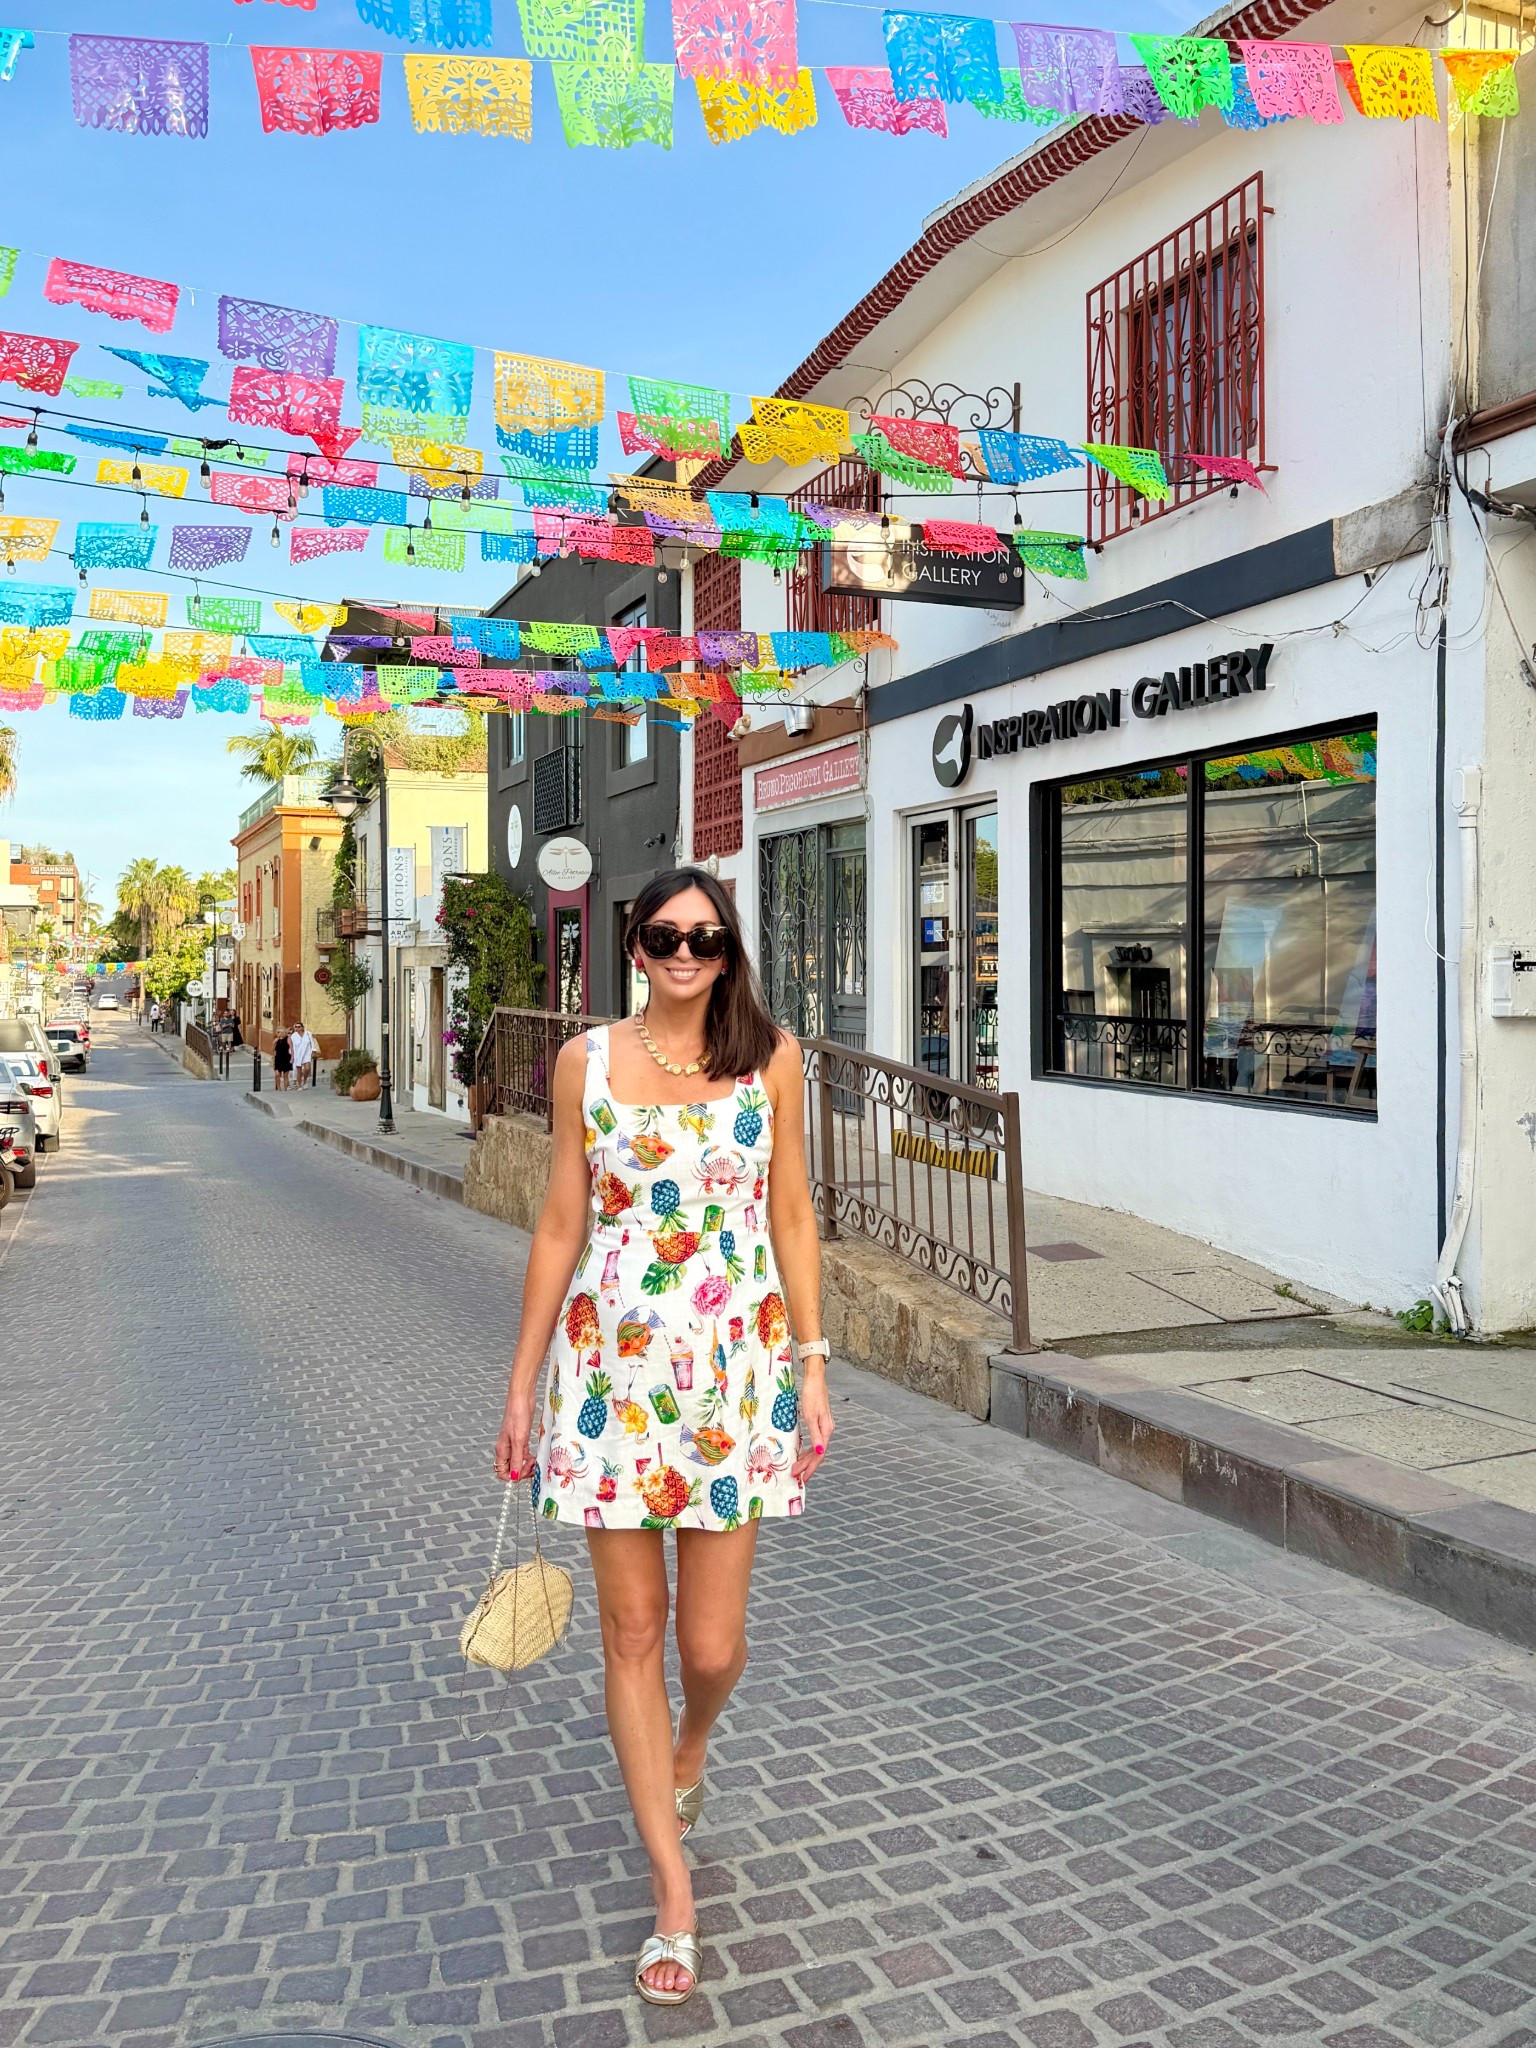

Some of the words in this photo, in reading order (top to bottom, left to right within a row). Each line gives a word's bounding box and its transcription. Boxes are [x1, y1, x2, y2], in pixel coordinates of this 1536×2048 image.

[902, 563, 981, 586] GALLERY
[977, 688, 1121, 760] INSPIRATION
[1132, 643, 1275, 719] GALLERY
[757, 778, 780, 800] BRUNO
[779, 766, 822, 795] PEGORETTI
[823, 756, 859, 783] GALLERY
[394, 855, 404, 926] EMOTIONS
